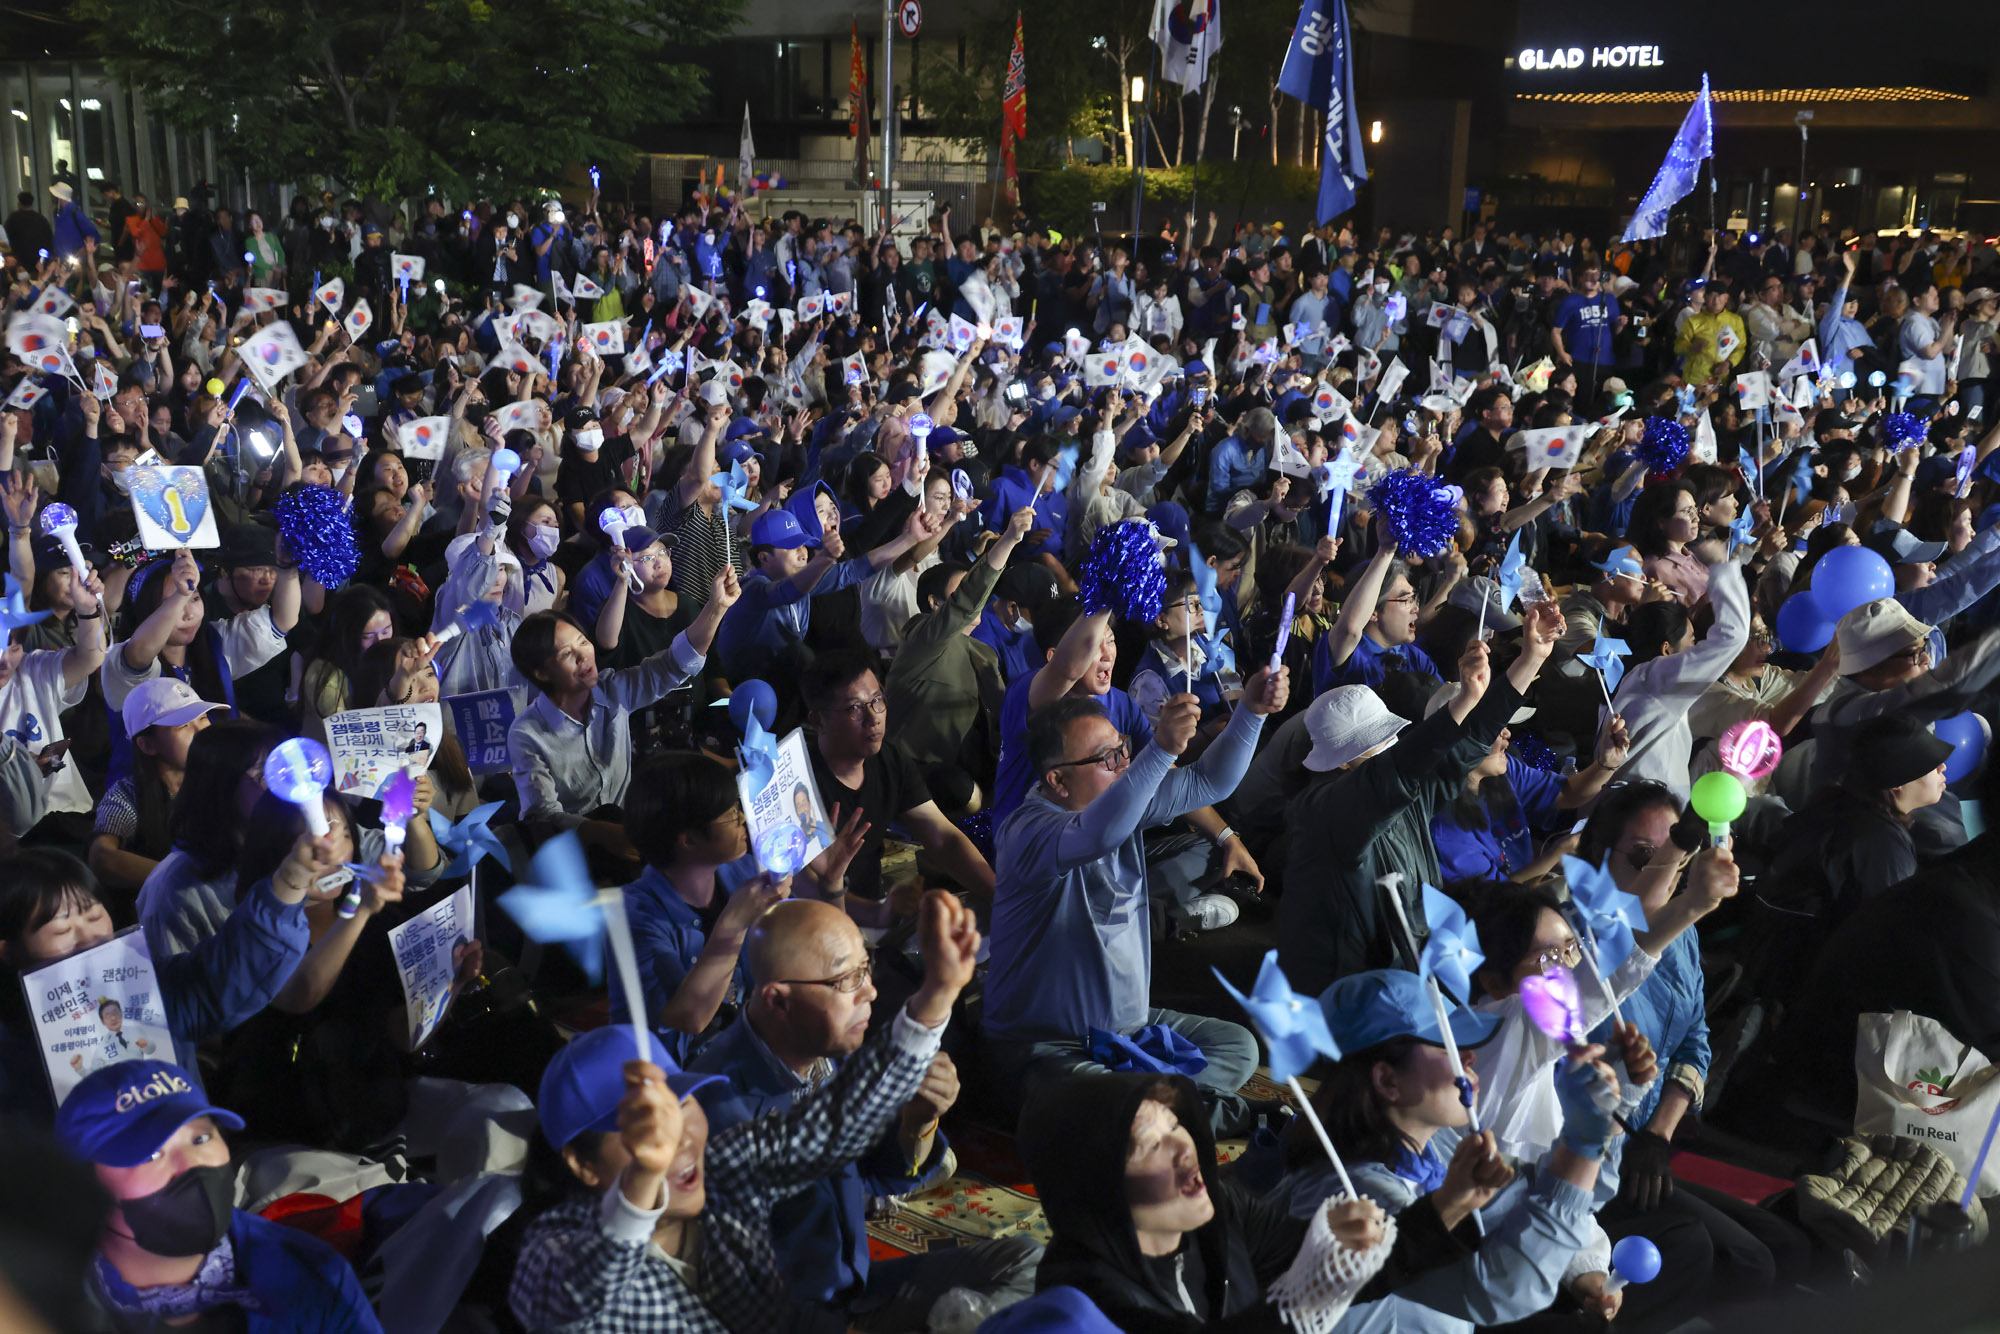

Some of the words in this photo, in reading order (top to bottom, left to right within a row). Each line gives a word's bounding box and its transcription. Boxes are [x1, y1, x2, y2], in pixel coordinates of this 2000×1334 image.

[1519, 49, 1584, 70] GLAD
[1592, 46, 1664, 68] HOTEL
[163, 486, 191, 534] 1
[331, 721, 381, 735] 잼통령
[384, 720, 416, 733] 당선
[333, 733, 384, 747] 다함께
[47, 981, 73, 1002] 이제
[42, 991, 90, 1024] 대한민국
[64, 1024, 95, 1037] 이재명이
[104, 1042, 118, 1059] 잼
[1906, 1123, 1924, 1136] I'm
